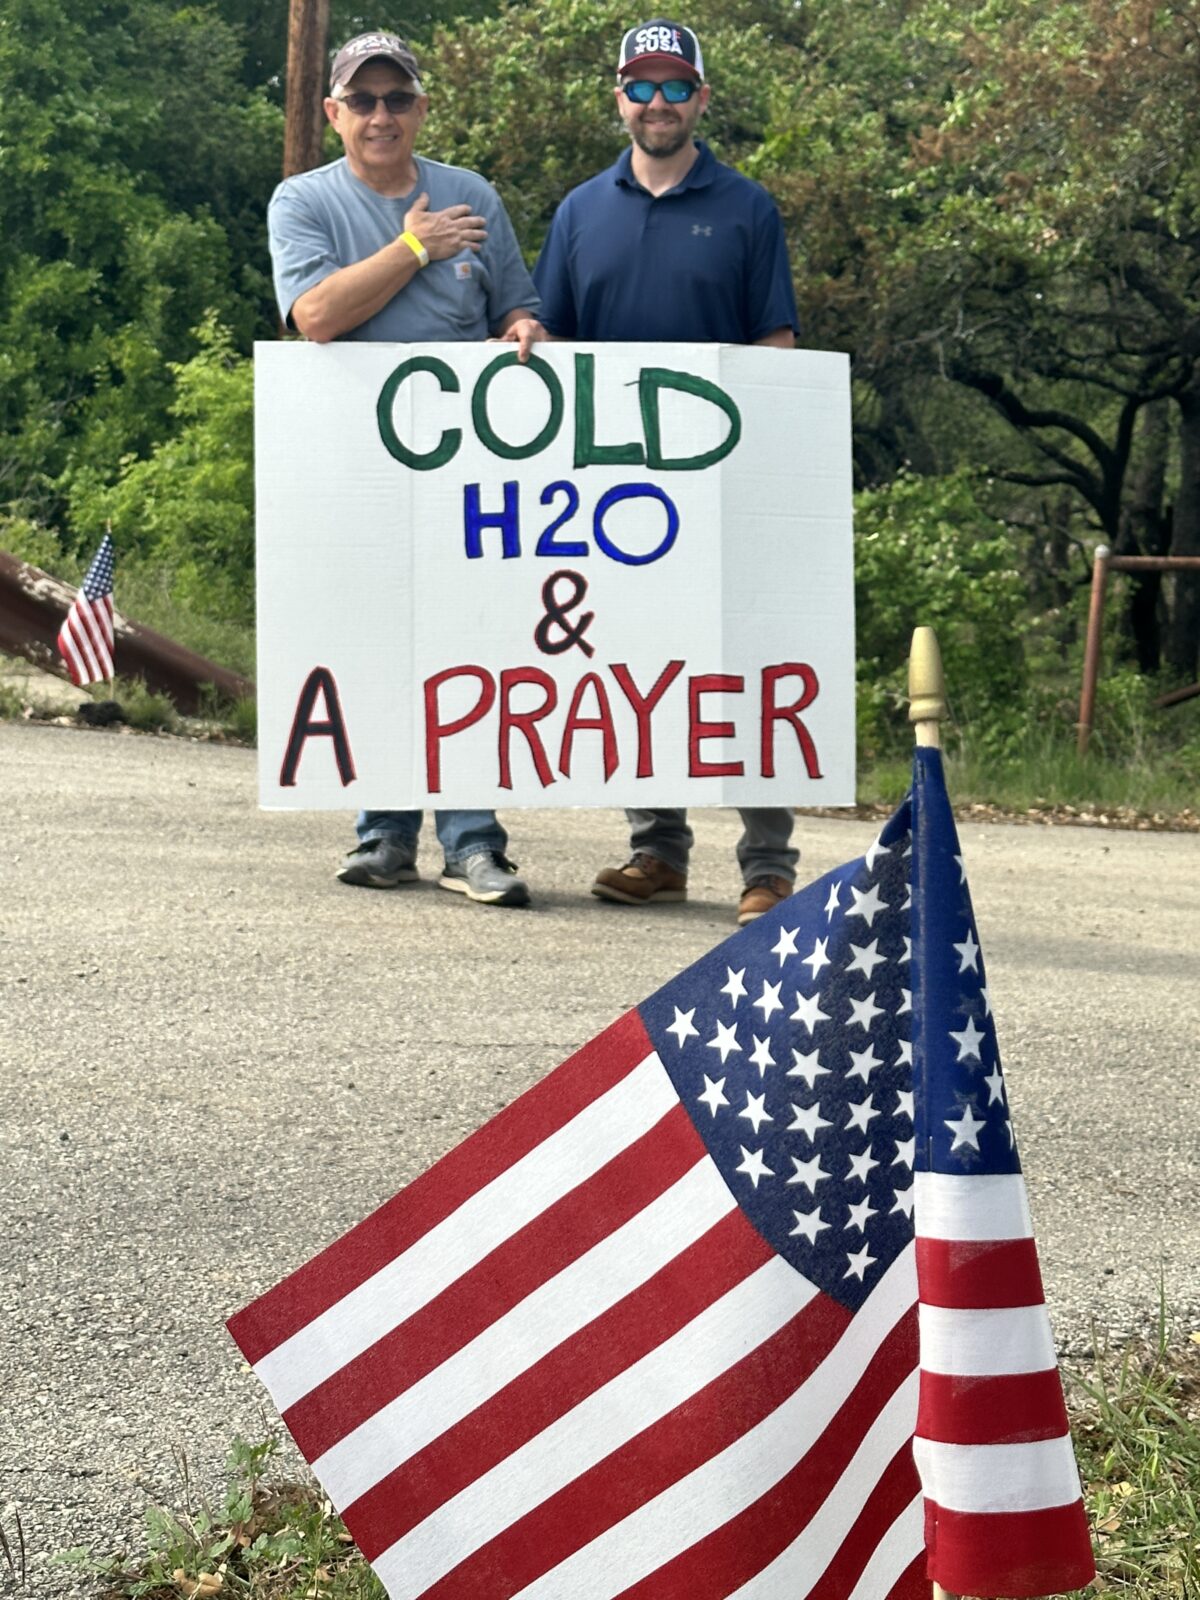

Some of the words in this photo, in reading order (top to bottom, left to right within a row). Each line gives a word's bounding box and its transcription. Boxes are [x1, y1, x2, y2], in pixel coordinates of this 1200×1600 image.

[646, 38, 683, 55] USA
[377, 350, 742, 471] COLD
[463, 480, 680, 566] H2O
[534, 569, 595, 659] &
[279, 666, 357, 787] A
[423, 659, 824, 793] PRAYER
